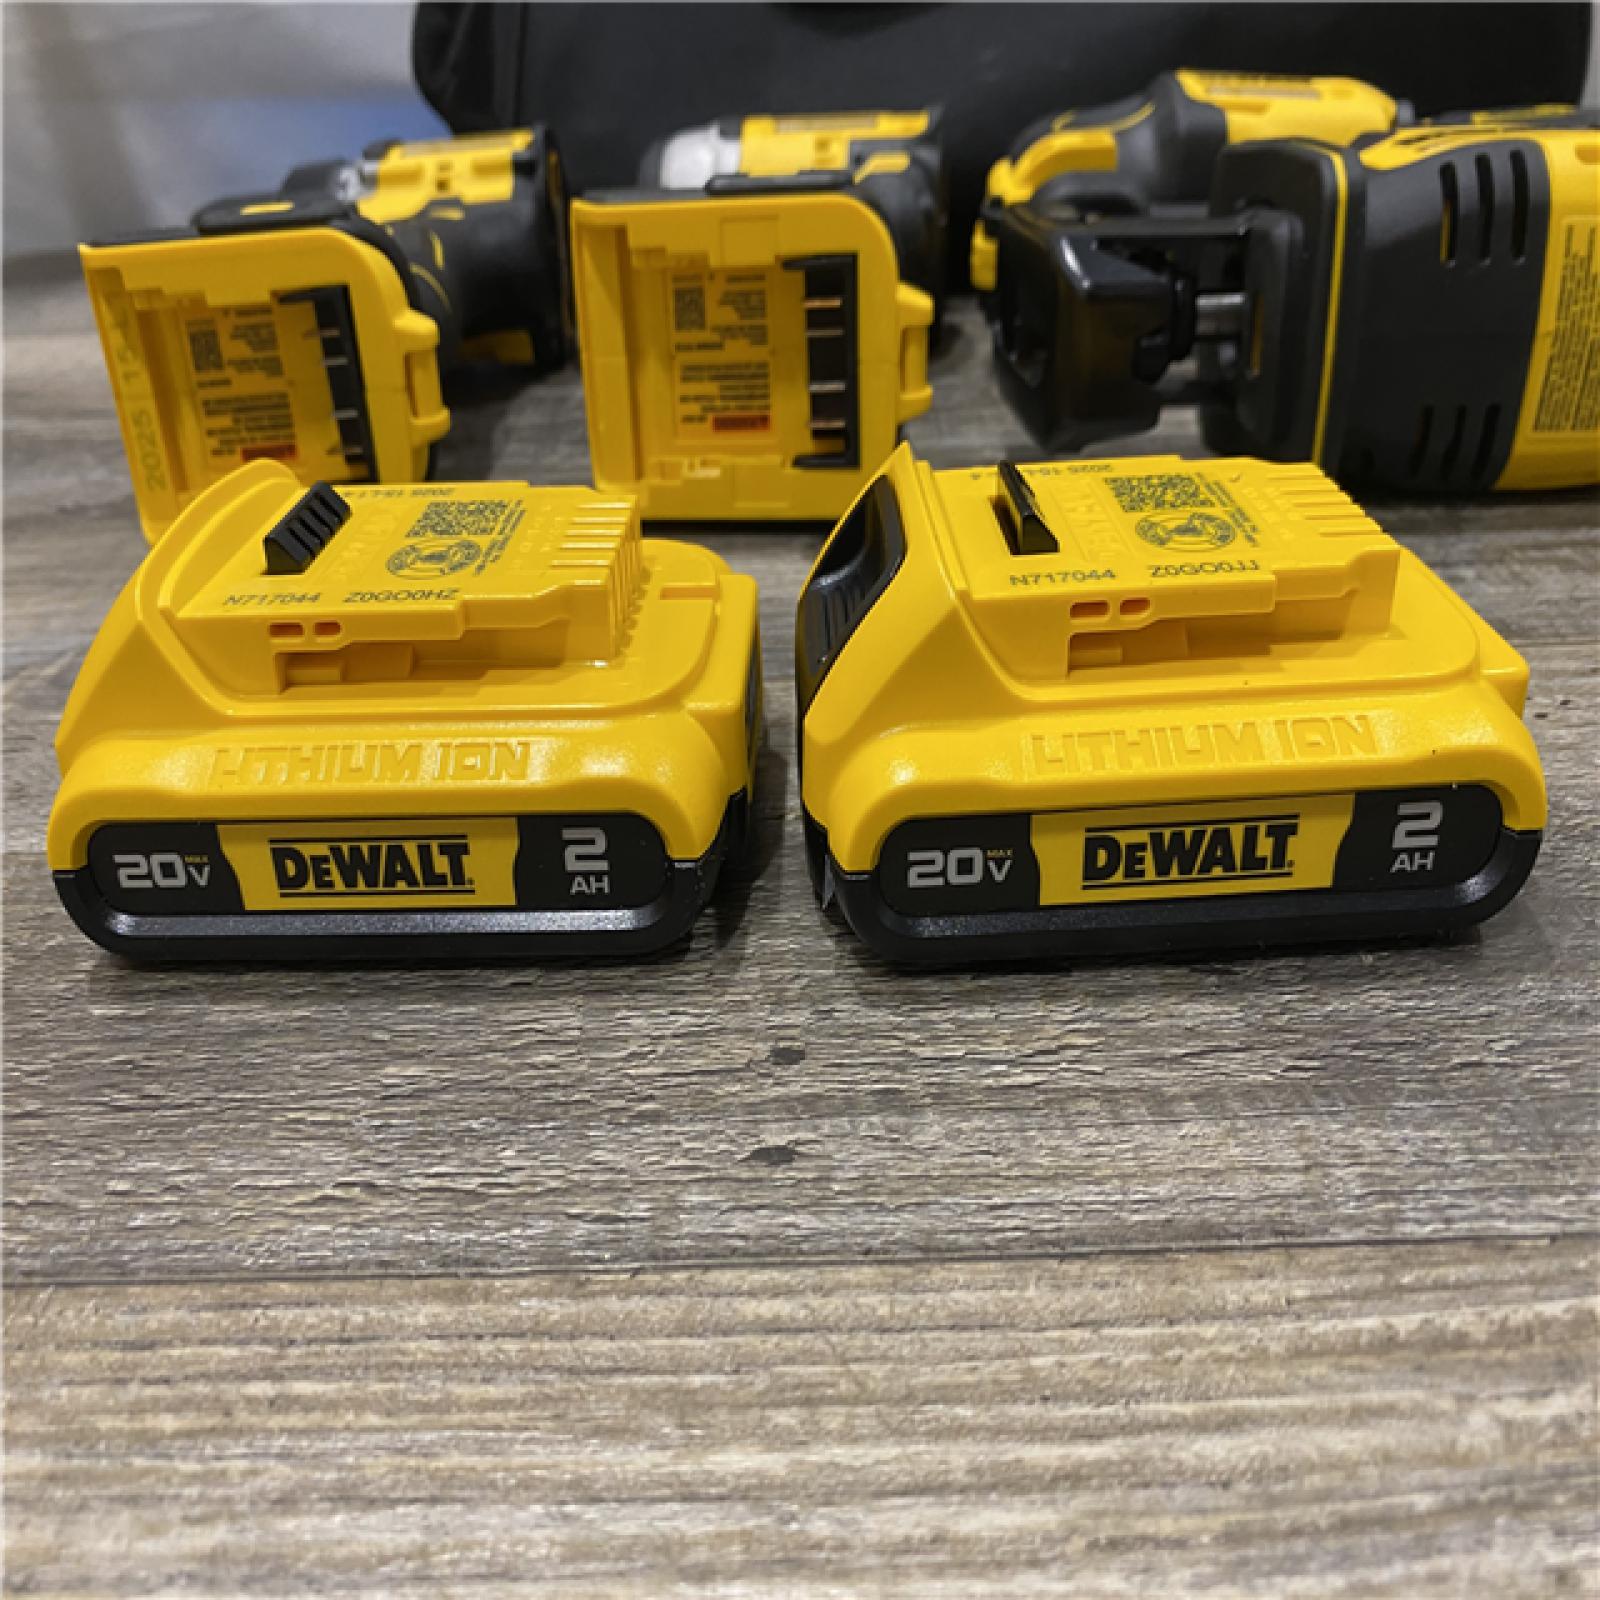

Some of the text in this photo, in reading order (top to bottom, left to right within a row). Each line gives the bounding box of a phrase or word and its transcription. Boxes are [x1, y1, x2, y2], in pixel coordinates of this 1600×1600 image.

[1009, 569, 1116, 587] N717044
[222, 591, 321, 606] N717044
[1030, 714, 1380, 775] LITHIUM ION
[212, 740, 532, 785] LITHIUM ION
[1392, 801, 1443, 849] 2
[561, 827, 610, 872] 2
[1389, 851, 1436, 874] AH
[569, 875, 611, 895] AH
